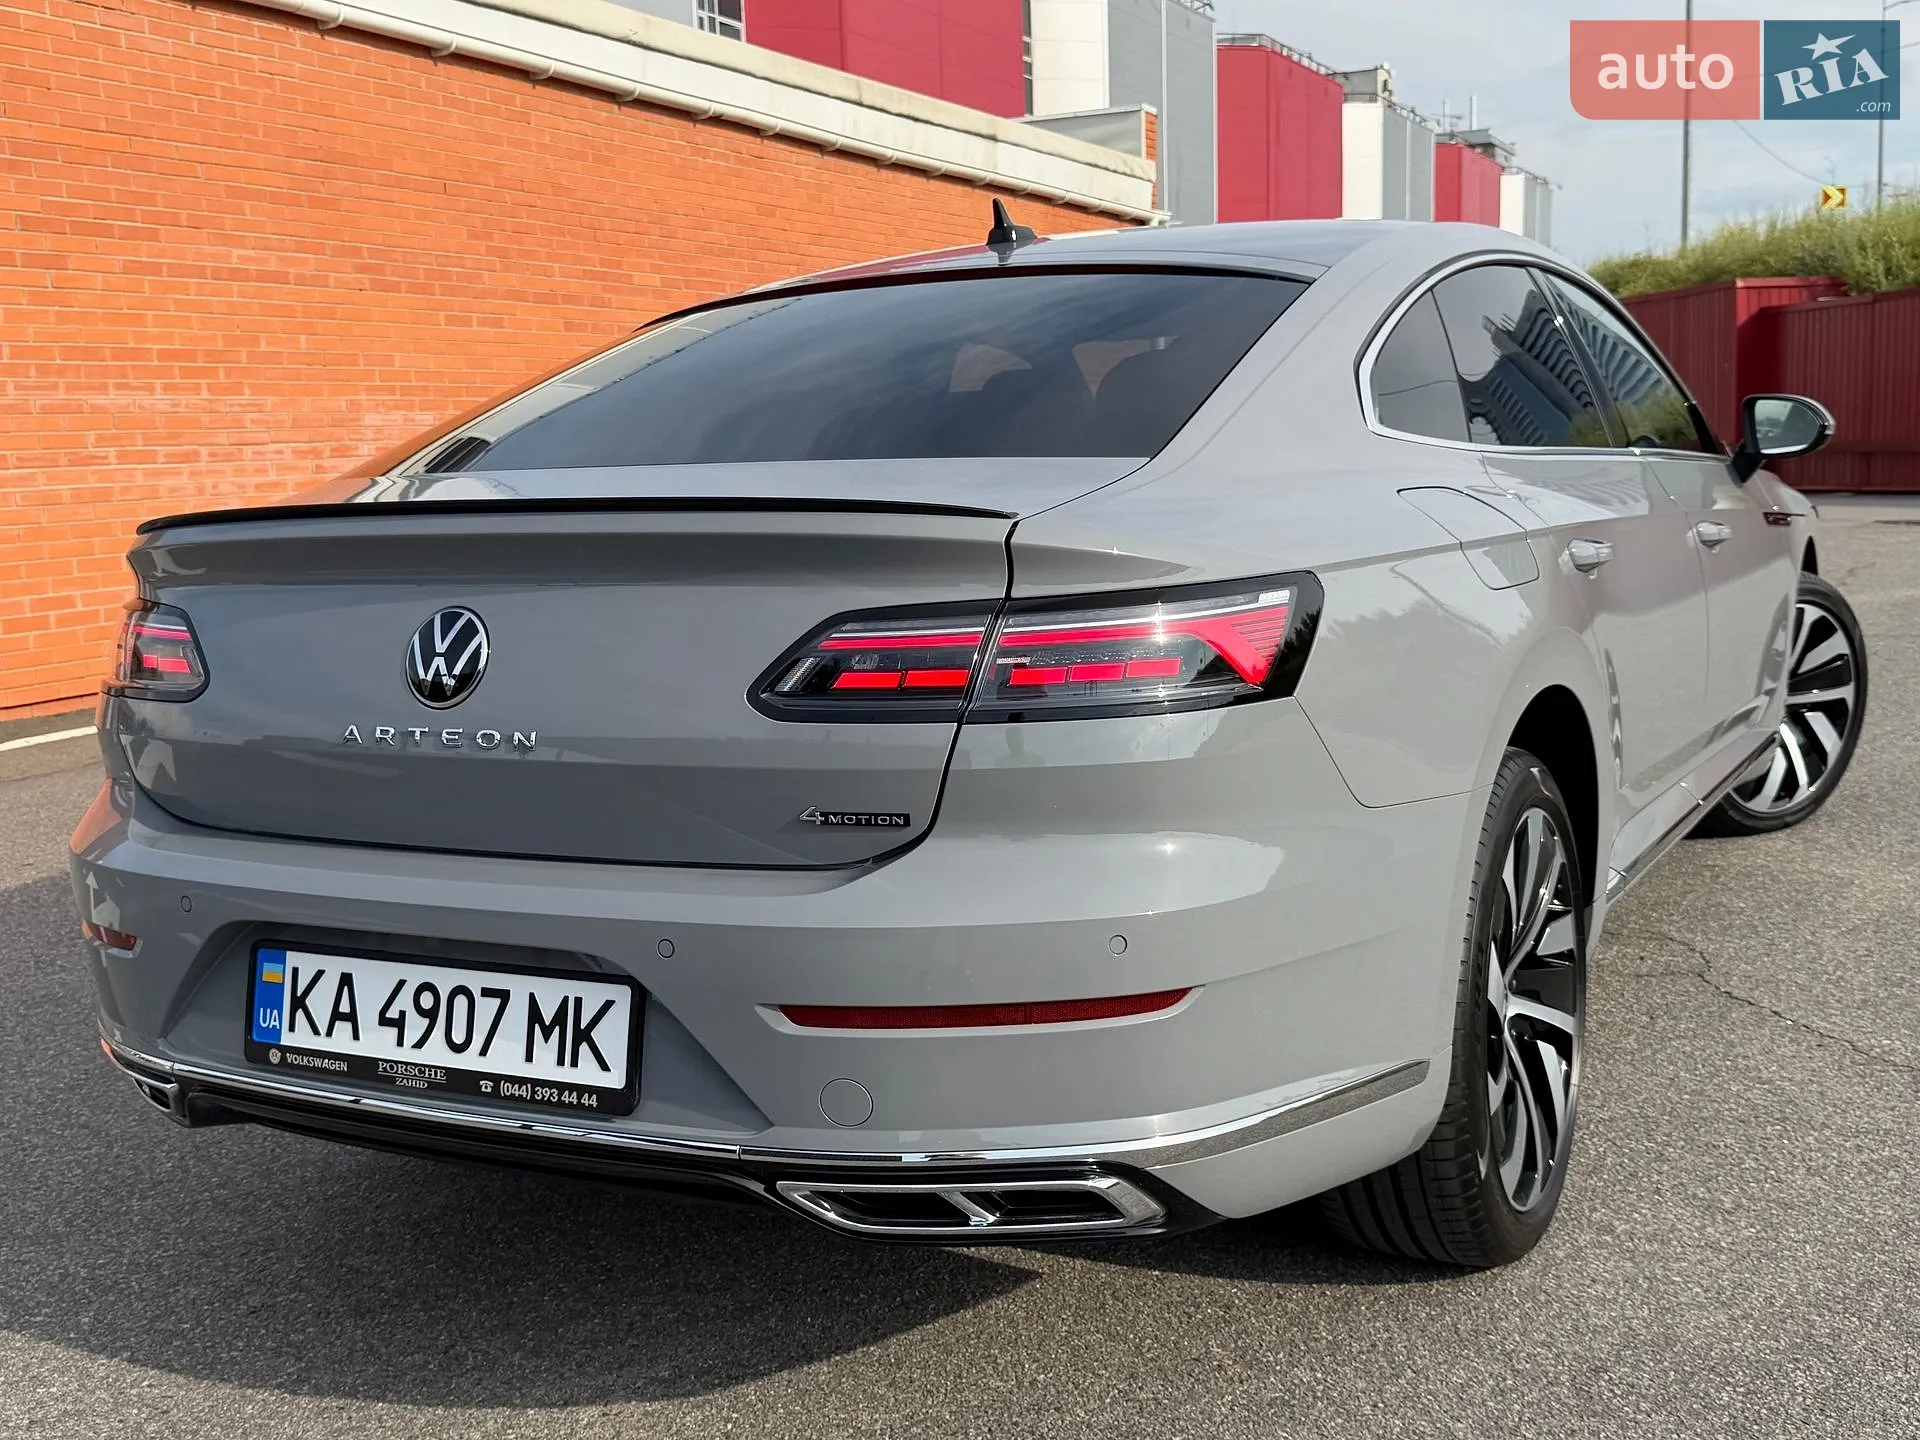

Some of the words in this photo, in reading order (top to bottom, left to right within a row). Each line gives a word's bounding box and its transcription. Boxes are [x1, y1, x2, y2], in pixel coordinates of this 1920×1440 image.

[343, 725, 538, 751] ARTEON
[800, 806, 904, 825] 4MOTION
[259, 1007, 280, 1030] UA
[289, 966, 361, 1041] KA
[378, 979, 511, 1057] 4907
[525, 992, 616, 1072] MK
[286, 1053, 348, 1072] VOLKSWAGEN
[378, 1061, 447, 1080] PORSCHE
[395, 1077, 428, 1089] ZAHID
[500, 1081, 531, 1100] (044)
[534, 1086, 558, 1102] 393
[561, 1091, 578, 1105] 44
[581, 1094, 598, 1108] 44
